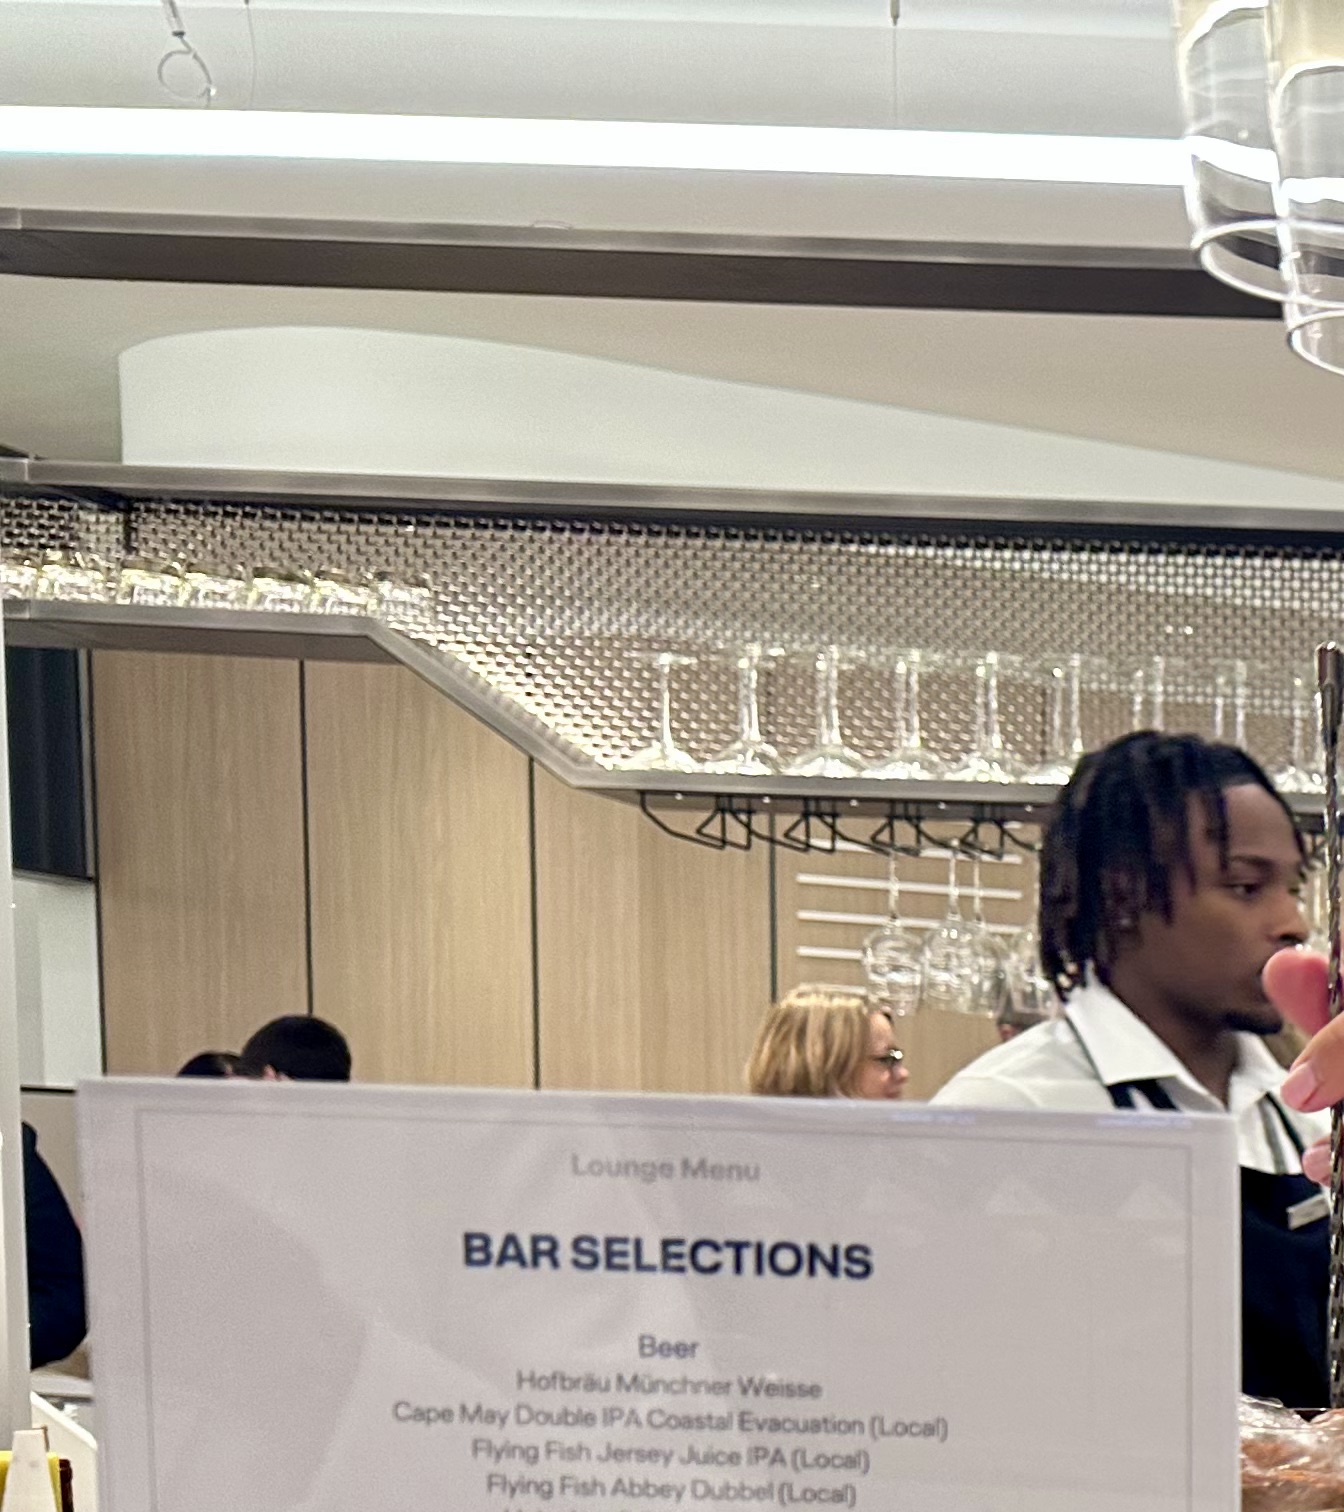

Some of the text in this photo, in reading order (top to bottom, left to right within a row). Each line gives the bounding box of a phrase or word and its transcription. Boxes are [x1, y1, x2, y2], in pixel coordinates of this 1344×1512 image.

[570, 1152, 761, 1185] Lounge Menu
[463, 1231, 874, 1280] BAR SELECTIONS
[637, 1333, 700, 1361] Beer
[515, 1369, 823, 1400] Hofbräu Münchner Weisse
[391, 1399, 949, 1443] Cape May Double IPA Coastal Evacuation (Local)
[471, 1436, 871, 1475] Flying Fish Jersey Juice IPA (Local)
[485, 1472, 857, 1509] Flying Fish Abbey Dubbel (Local)
